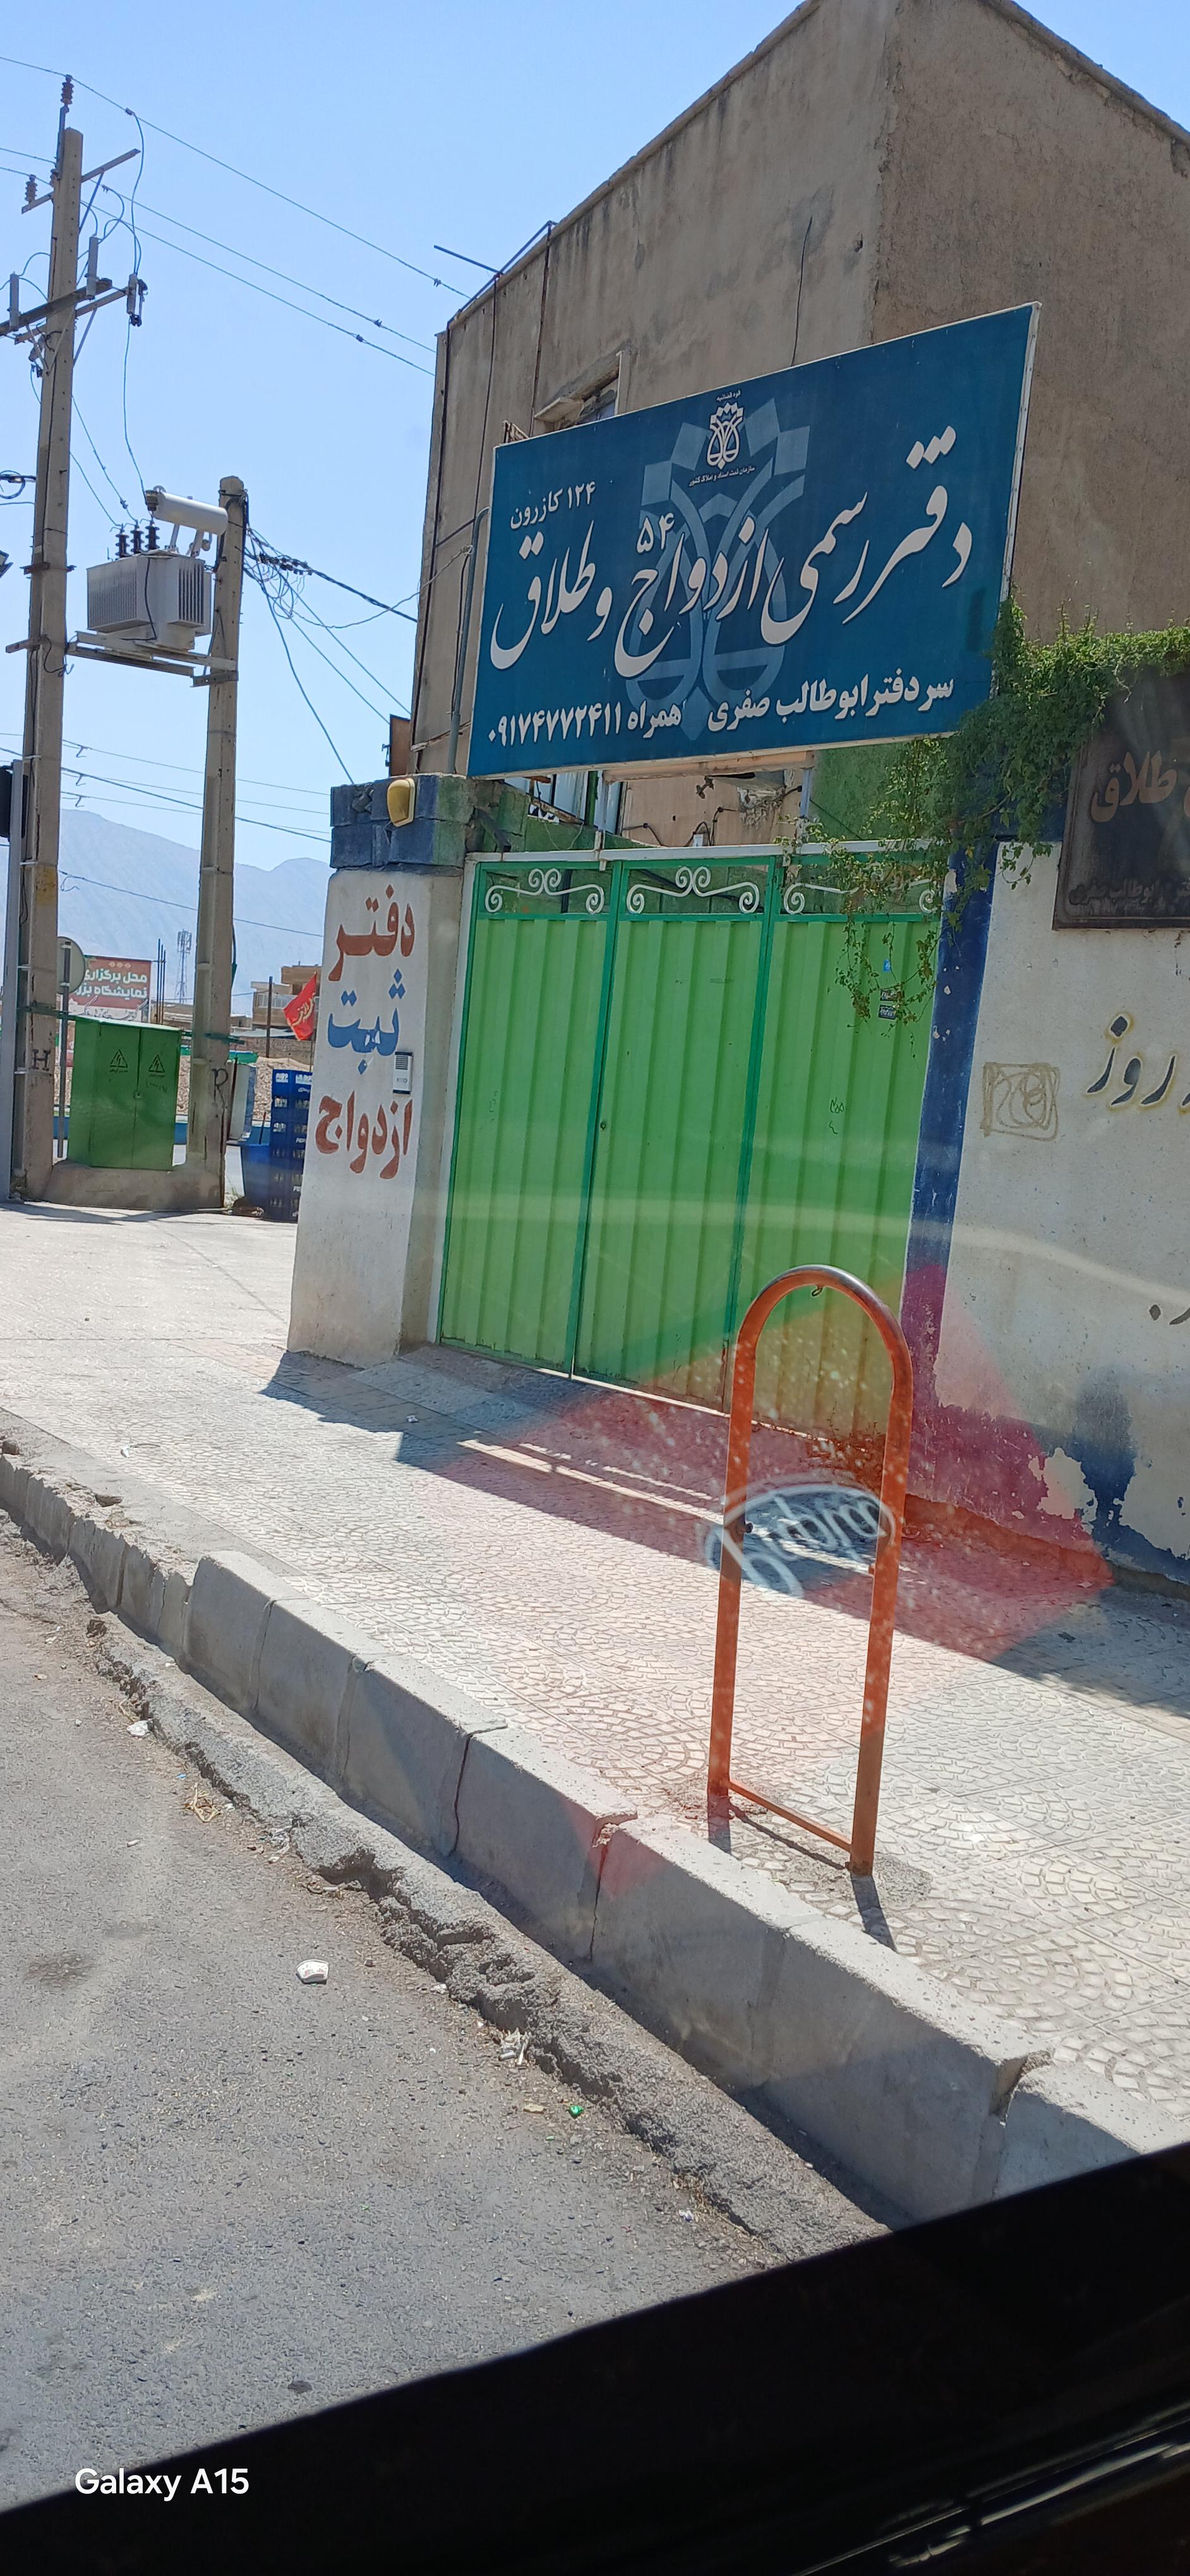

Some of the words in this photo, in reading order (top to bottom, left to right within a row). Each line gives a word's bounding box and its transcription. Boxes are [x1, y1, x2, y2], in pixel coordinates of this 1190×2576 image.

[510, 488, 563, 529] کازرون
[568, 481, 596, 510] ۱۲۴
[636, 513, 675, 554] ۵۴
[843, 426, 973, 624] دفتر
[760, 491, 870, 645] رسمی
[615, 516, 769, 677] ازدواج
[627, 699, 683, 739] همراه
[707, 689, 771, 732] صفری
[776, 673, 869, 725] ابوطالب
[488, 701, 622, 747] ۰۹۱۷۴۷۷۲۴۱۱
[1090, 750, 1178, 823] طلاق
[328, 884, 416, 982] دفتر
[73, 982, 92, 997] بزر
[123, 972, 147, 984] محل
[327, 969, 406, 1075] ثبت
[315, 1090, 414, 1179] ازدواج
